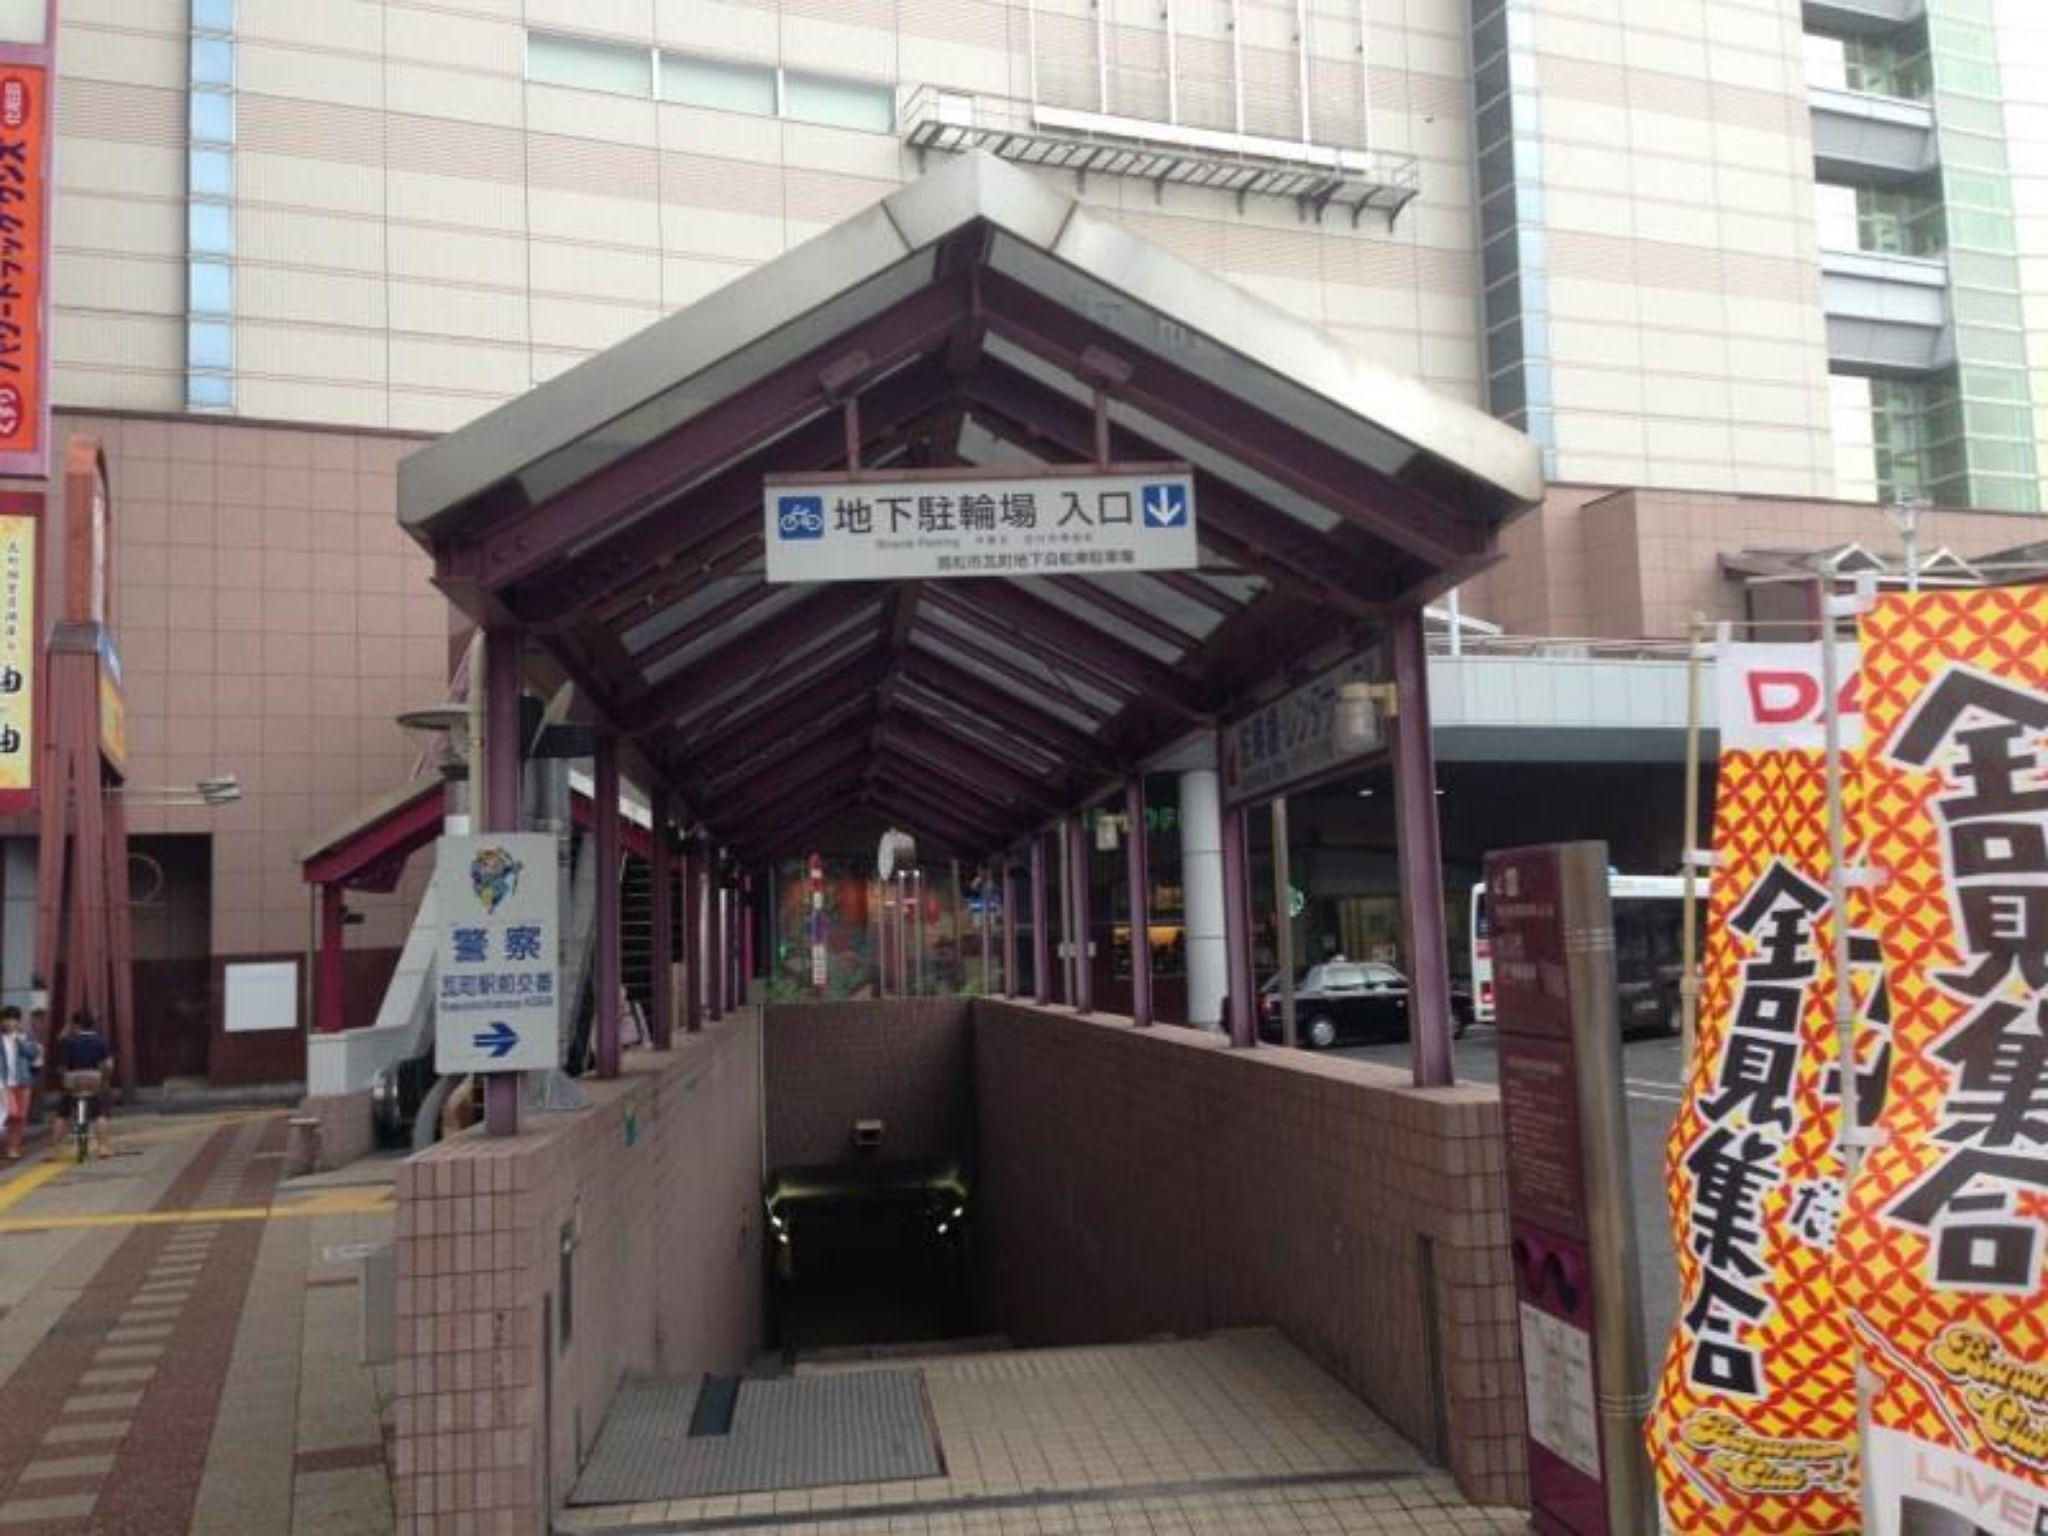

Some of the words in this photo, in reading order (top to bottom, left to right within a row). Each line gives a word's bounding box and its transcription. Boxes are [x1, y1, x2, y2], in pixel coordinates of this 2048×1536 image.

[833, 493, 1037, 534] 地下駐輪場
[1056, 491, 1132, 526] 入口
[451, 926, 542, 962] 警察
[1685, 861, 1831, 1393] 全員集合
[1916, 1452, 2035, 1531] LIVE
